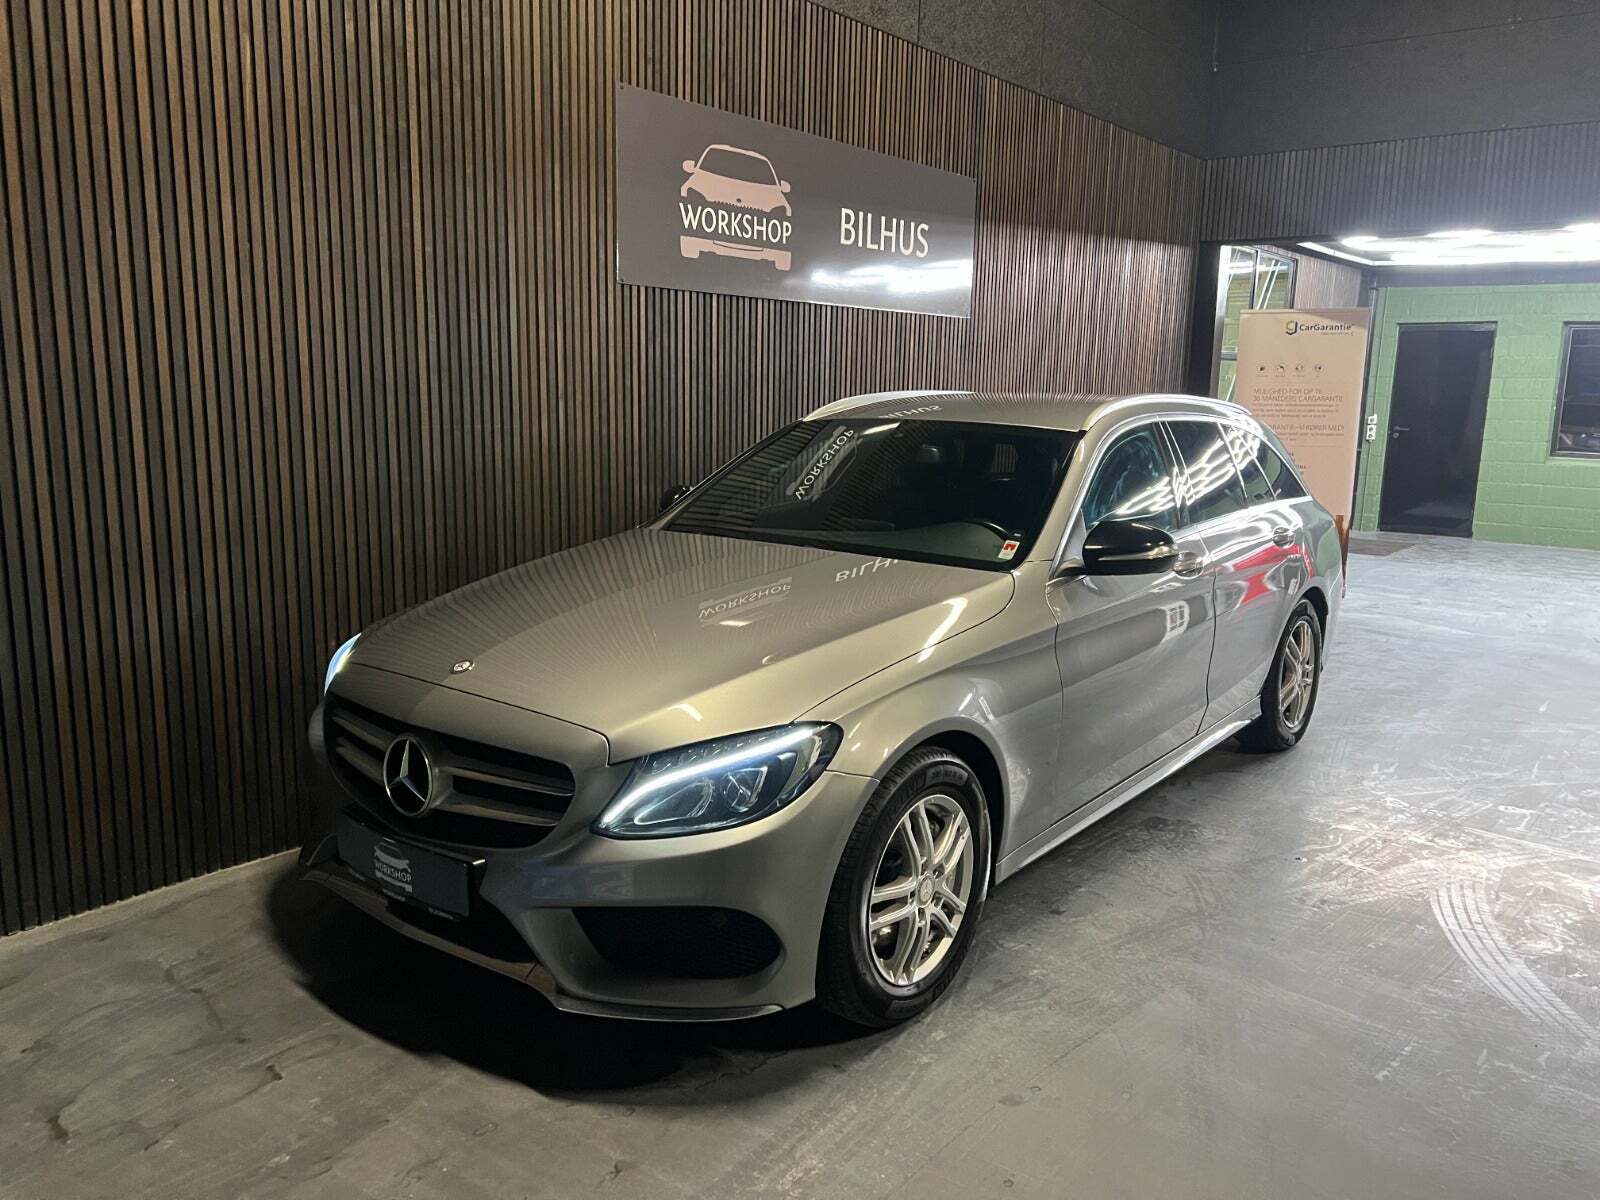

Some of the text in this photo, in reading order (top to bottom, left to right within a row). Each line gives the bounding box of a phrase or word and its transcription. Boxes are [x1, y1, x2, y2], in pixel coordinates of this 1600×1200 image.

[679, 202, 792, 244] WORKSHOP
[840, 207, 930, 258] BILHUS
[1299, 323, 1352, 332] CarGarantie
[375, 861, 412, 882] WORKSHOP
